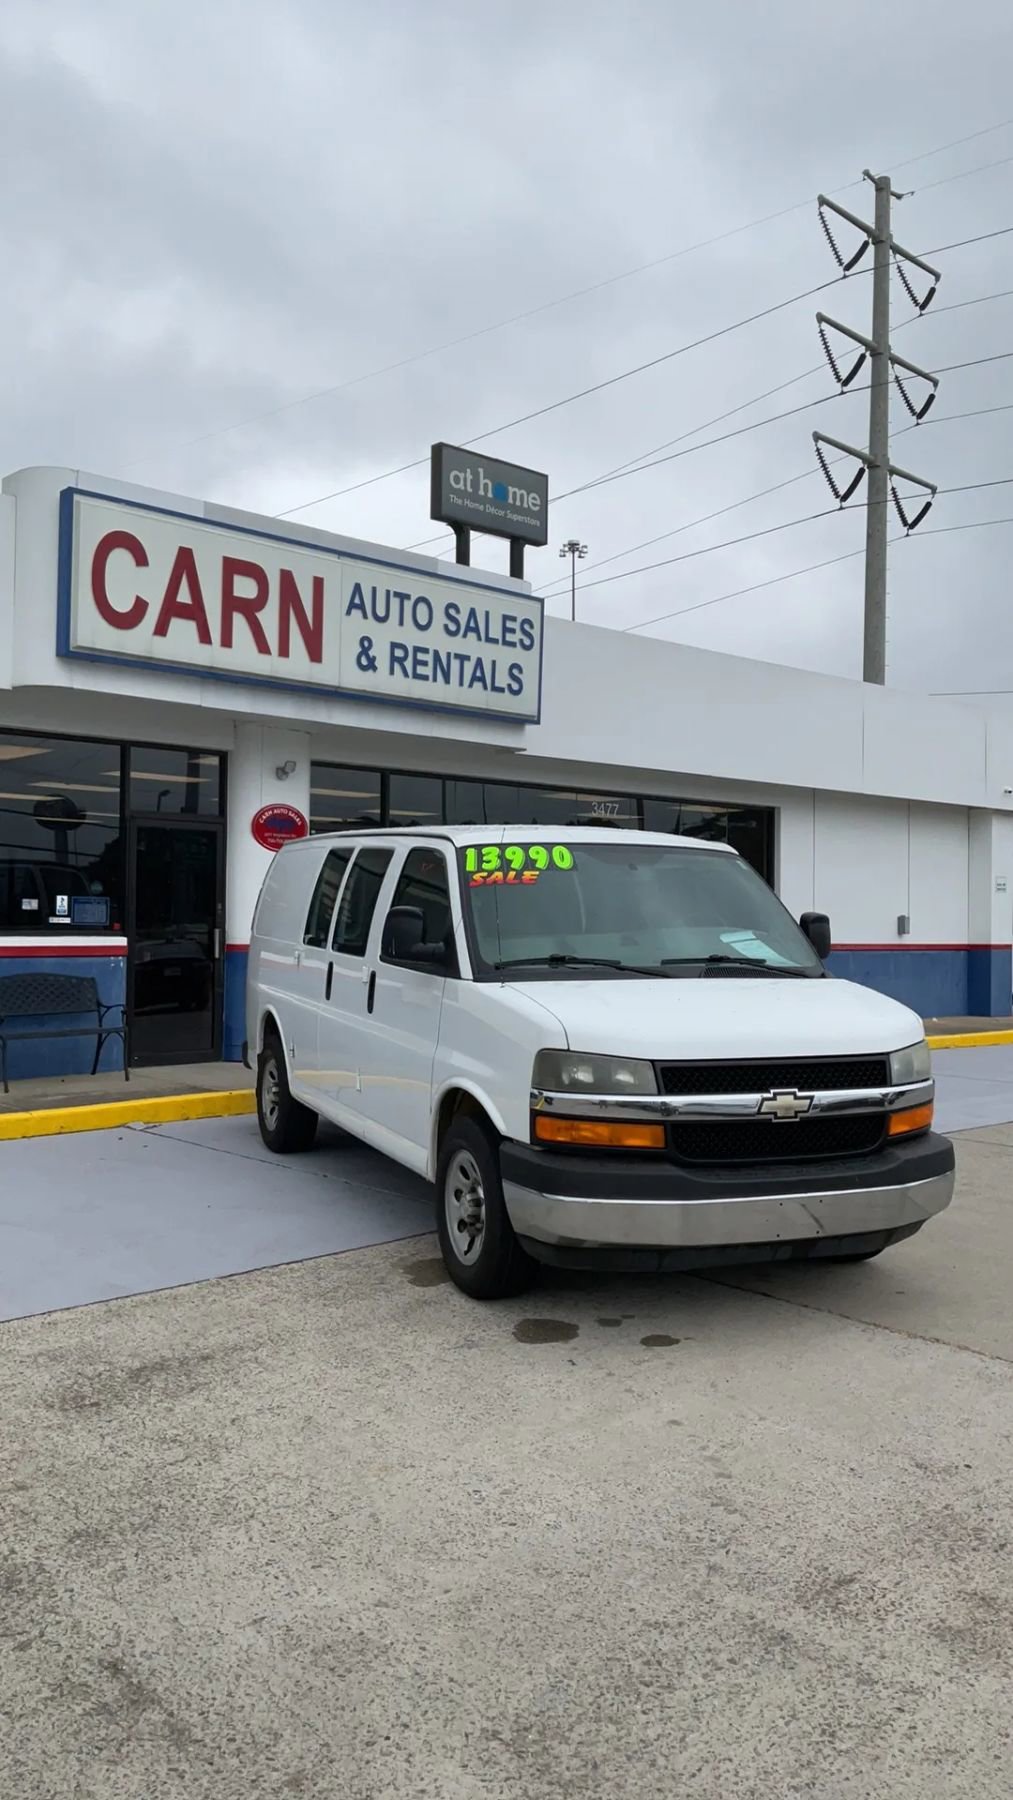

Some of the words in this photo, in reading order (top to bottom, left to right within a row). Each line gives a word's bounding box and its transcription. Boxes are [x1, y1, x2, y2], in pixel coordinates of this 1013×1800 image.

[449, 468, 473, 492] at
[478, 467, 541, 511] home
[449, 494, 463, 506] The
[464, 498, 484, 511] Home
[507, 511, 540, 527] Superstore
[91, 529, 324, 664] CARN
[345, 582, 434, 632] AUTO
[443, 601, 535, 652] SALES
[356, 635, 379, 673] &
[389, 641, 524, 697] RENTALS
[591, 801, 619, 817] 3477
[465, 845, 574, 872] 13990
[469, 871, 539, 888] SALE
